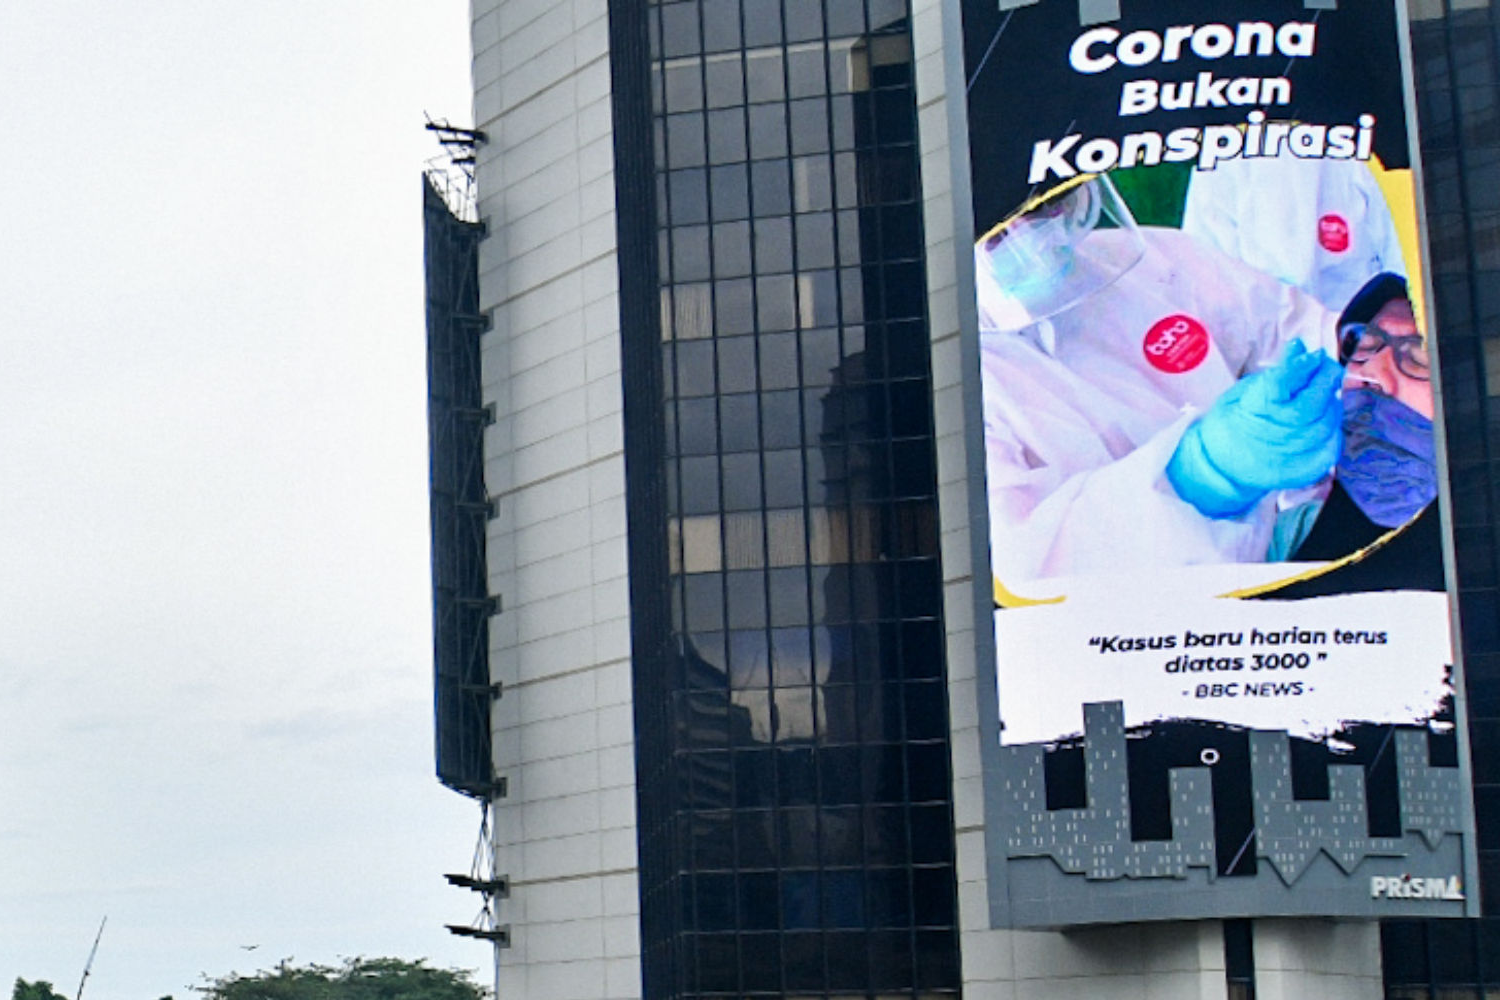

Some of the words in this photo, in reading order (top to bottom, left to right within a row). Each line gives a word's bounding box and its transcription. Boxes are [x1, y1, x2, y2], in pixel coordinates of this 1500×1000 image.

[1068, 21, 1317, 74] Corona
[1119, 72, 1292, 116] Bukan
[1028, 111, 1376, 184] Konspirasi
[1184, 630, 1243, 648] baru
[1250, 626, 1327, 646] harian
[1333, 628, 1388, 645] terus
[1164, 654, 1244, 673] diatas
[1195, 682, 1240, 698] BBC
[1244, 681, 1304, 697] NEWS
